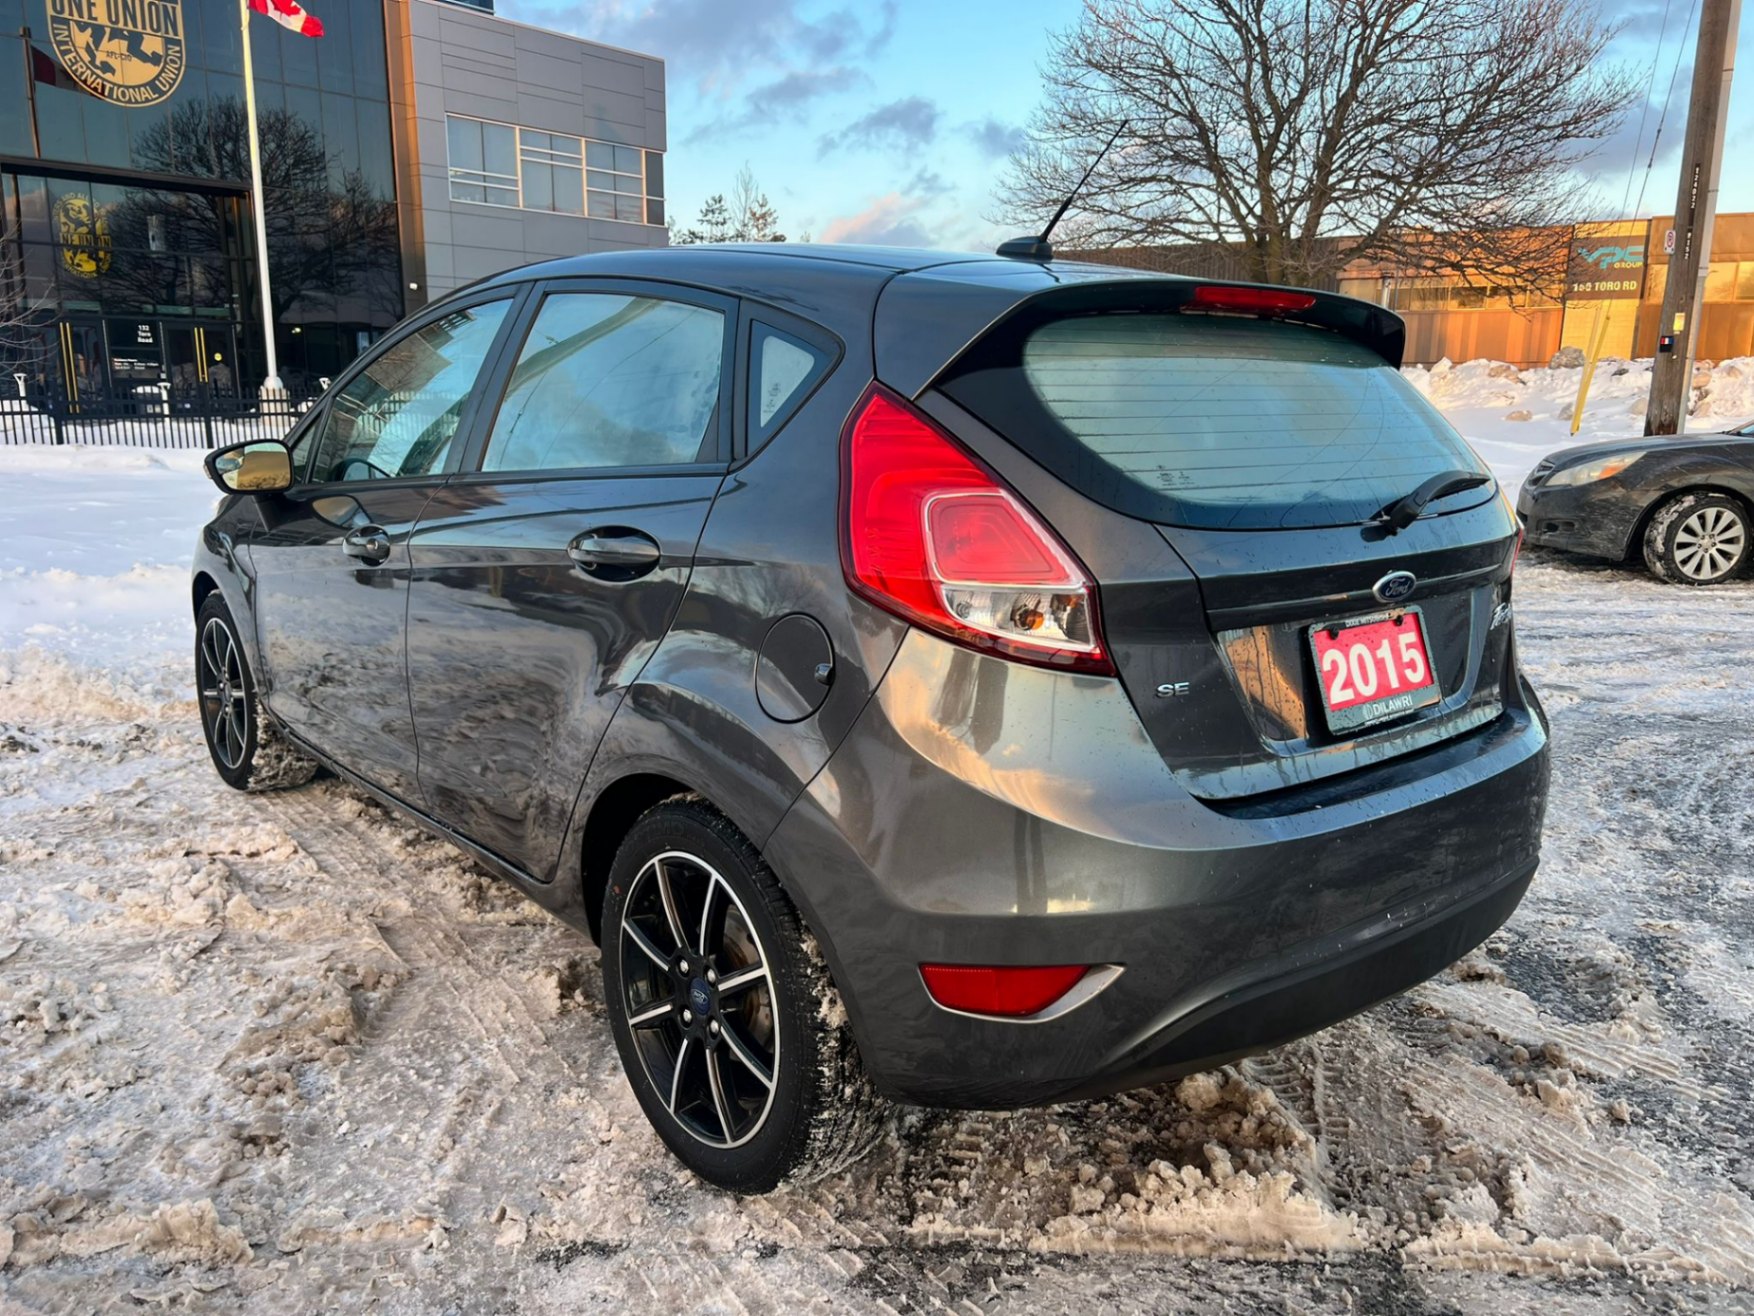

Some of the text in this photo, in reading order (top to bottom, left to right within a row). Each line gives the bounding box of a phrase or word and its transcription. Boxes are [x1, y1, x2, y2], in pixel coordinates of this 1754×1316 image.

[105, 0, 179, 37] UNION
[52, 23, 181, 103] INTERNATIONAL UNION
[1614, 261, 1644, 269] GROUP
[1594, 281, 1621, 291] TORO
[1622, 280, 1638, 290] RD
[1385, 578, 1411, 597] Ford
[1322, 632, 1425, 705] 2015
[1157, 681, 1190, 697] SE
[1372, 694, 1413, 716] DILAWRI
